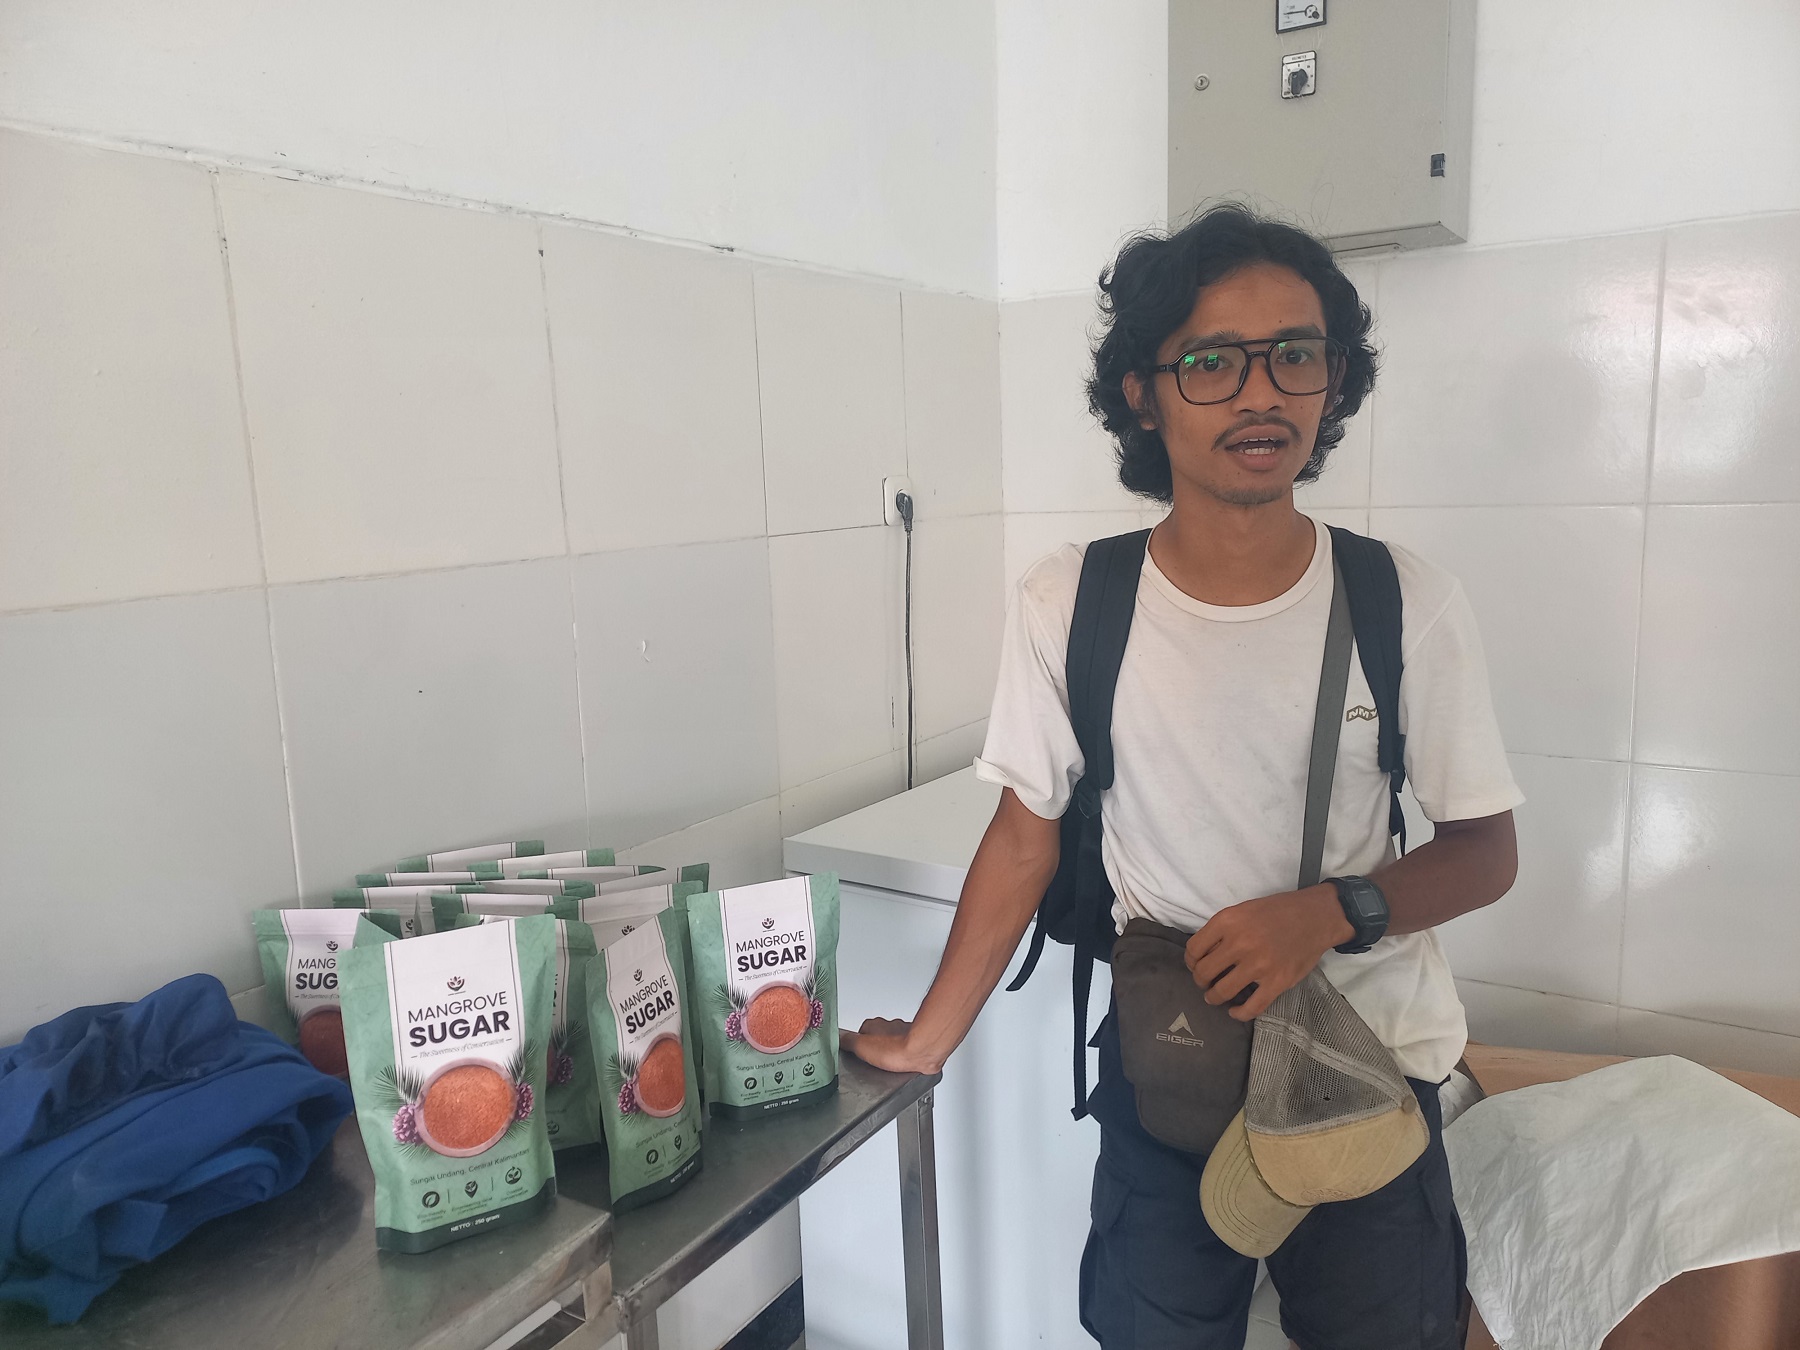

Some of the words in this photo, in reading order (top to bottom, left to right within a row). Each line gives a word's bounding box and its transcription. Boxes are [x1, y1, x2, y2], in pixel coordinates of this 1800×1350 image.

[736, 931, 805, 953] MANGROVE
[297, 958, 336, 969] MANG
[737, 945, 807, 973] SUGAR
[295, 972, 338, 990] SUG
[619, 975, 668, 1013] MANGROVE
[408, 991, 507, 1023] MANGROVE
[625, 990, 675, 1033] SUGAR
[409, 1010, 510, 1047] SUGAR
[1156, 1033, 1204, 1047] EIGER
[468, 1161, 493, 1172] Central
[494, 1148, 530, 1165] Kalimantan
[451, 1222, 470, 1232] NETTO
